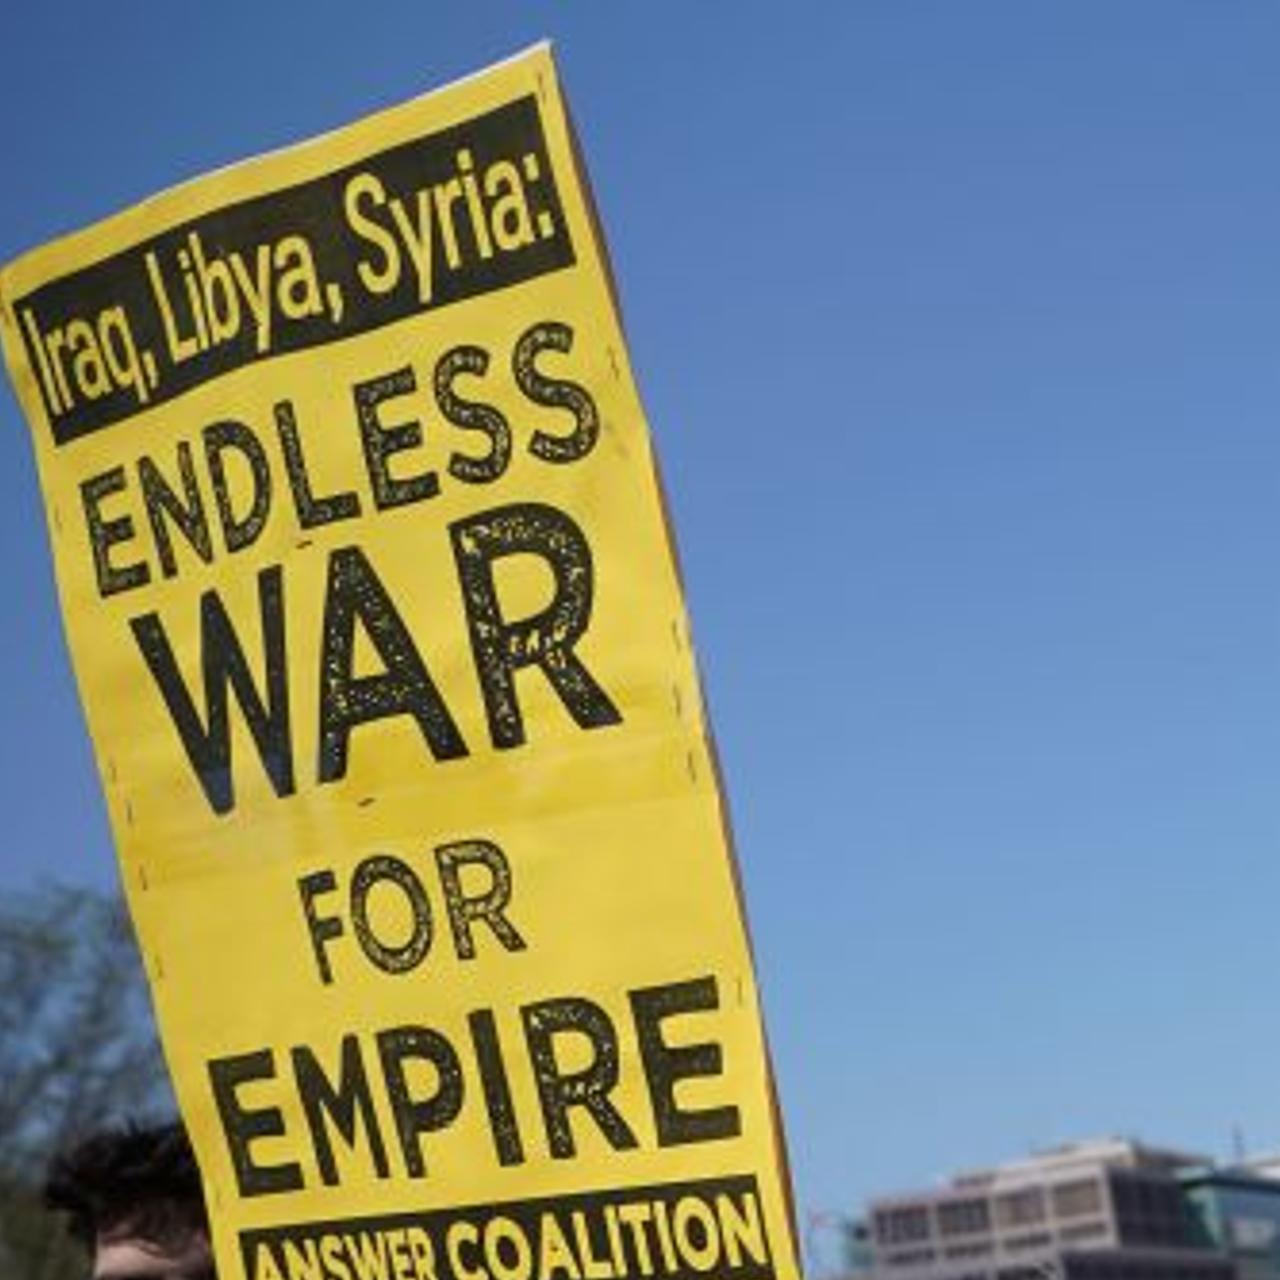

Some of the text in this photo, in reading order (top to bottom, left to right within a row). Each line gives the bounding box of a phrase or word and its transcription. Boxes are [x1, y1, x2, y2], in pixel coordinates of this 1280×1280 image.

[24, 148, 556, 416] Iraq, Libya, Syria:
[79, 321, 600, 600] ENDLESS
[130, 501, 624, 816] WAR
[297, 839, 526, 986] FOR
[207, 975, 743, 1198] EMPIRE
